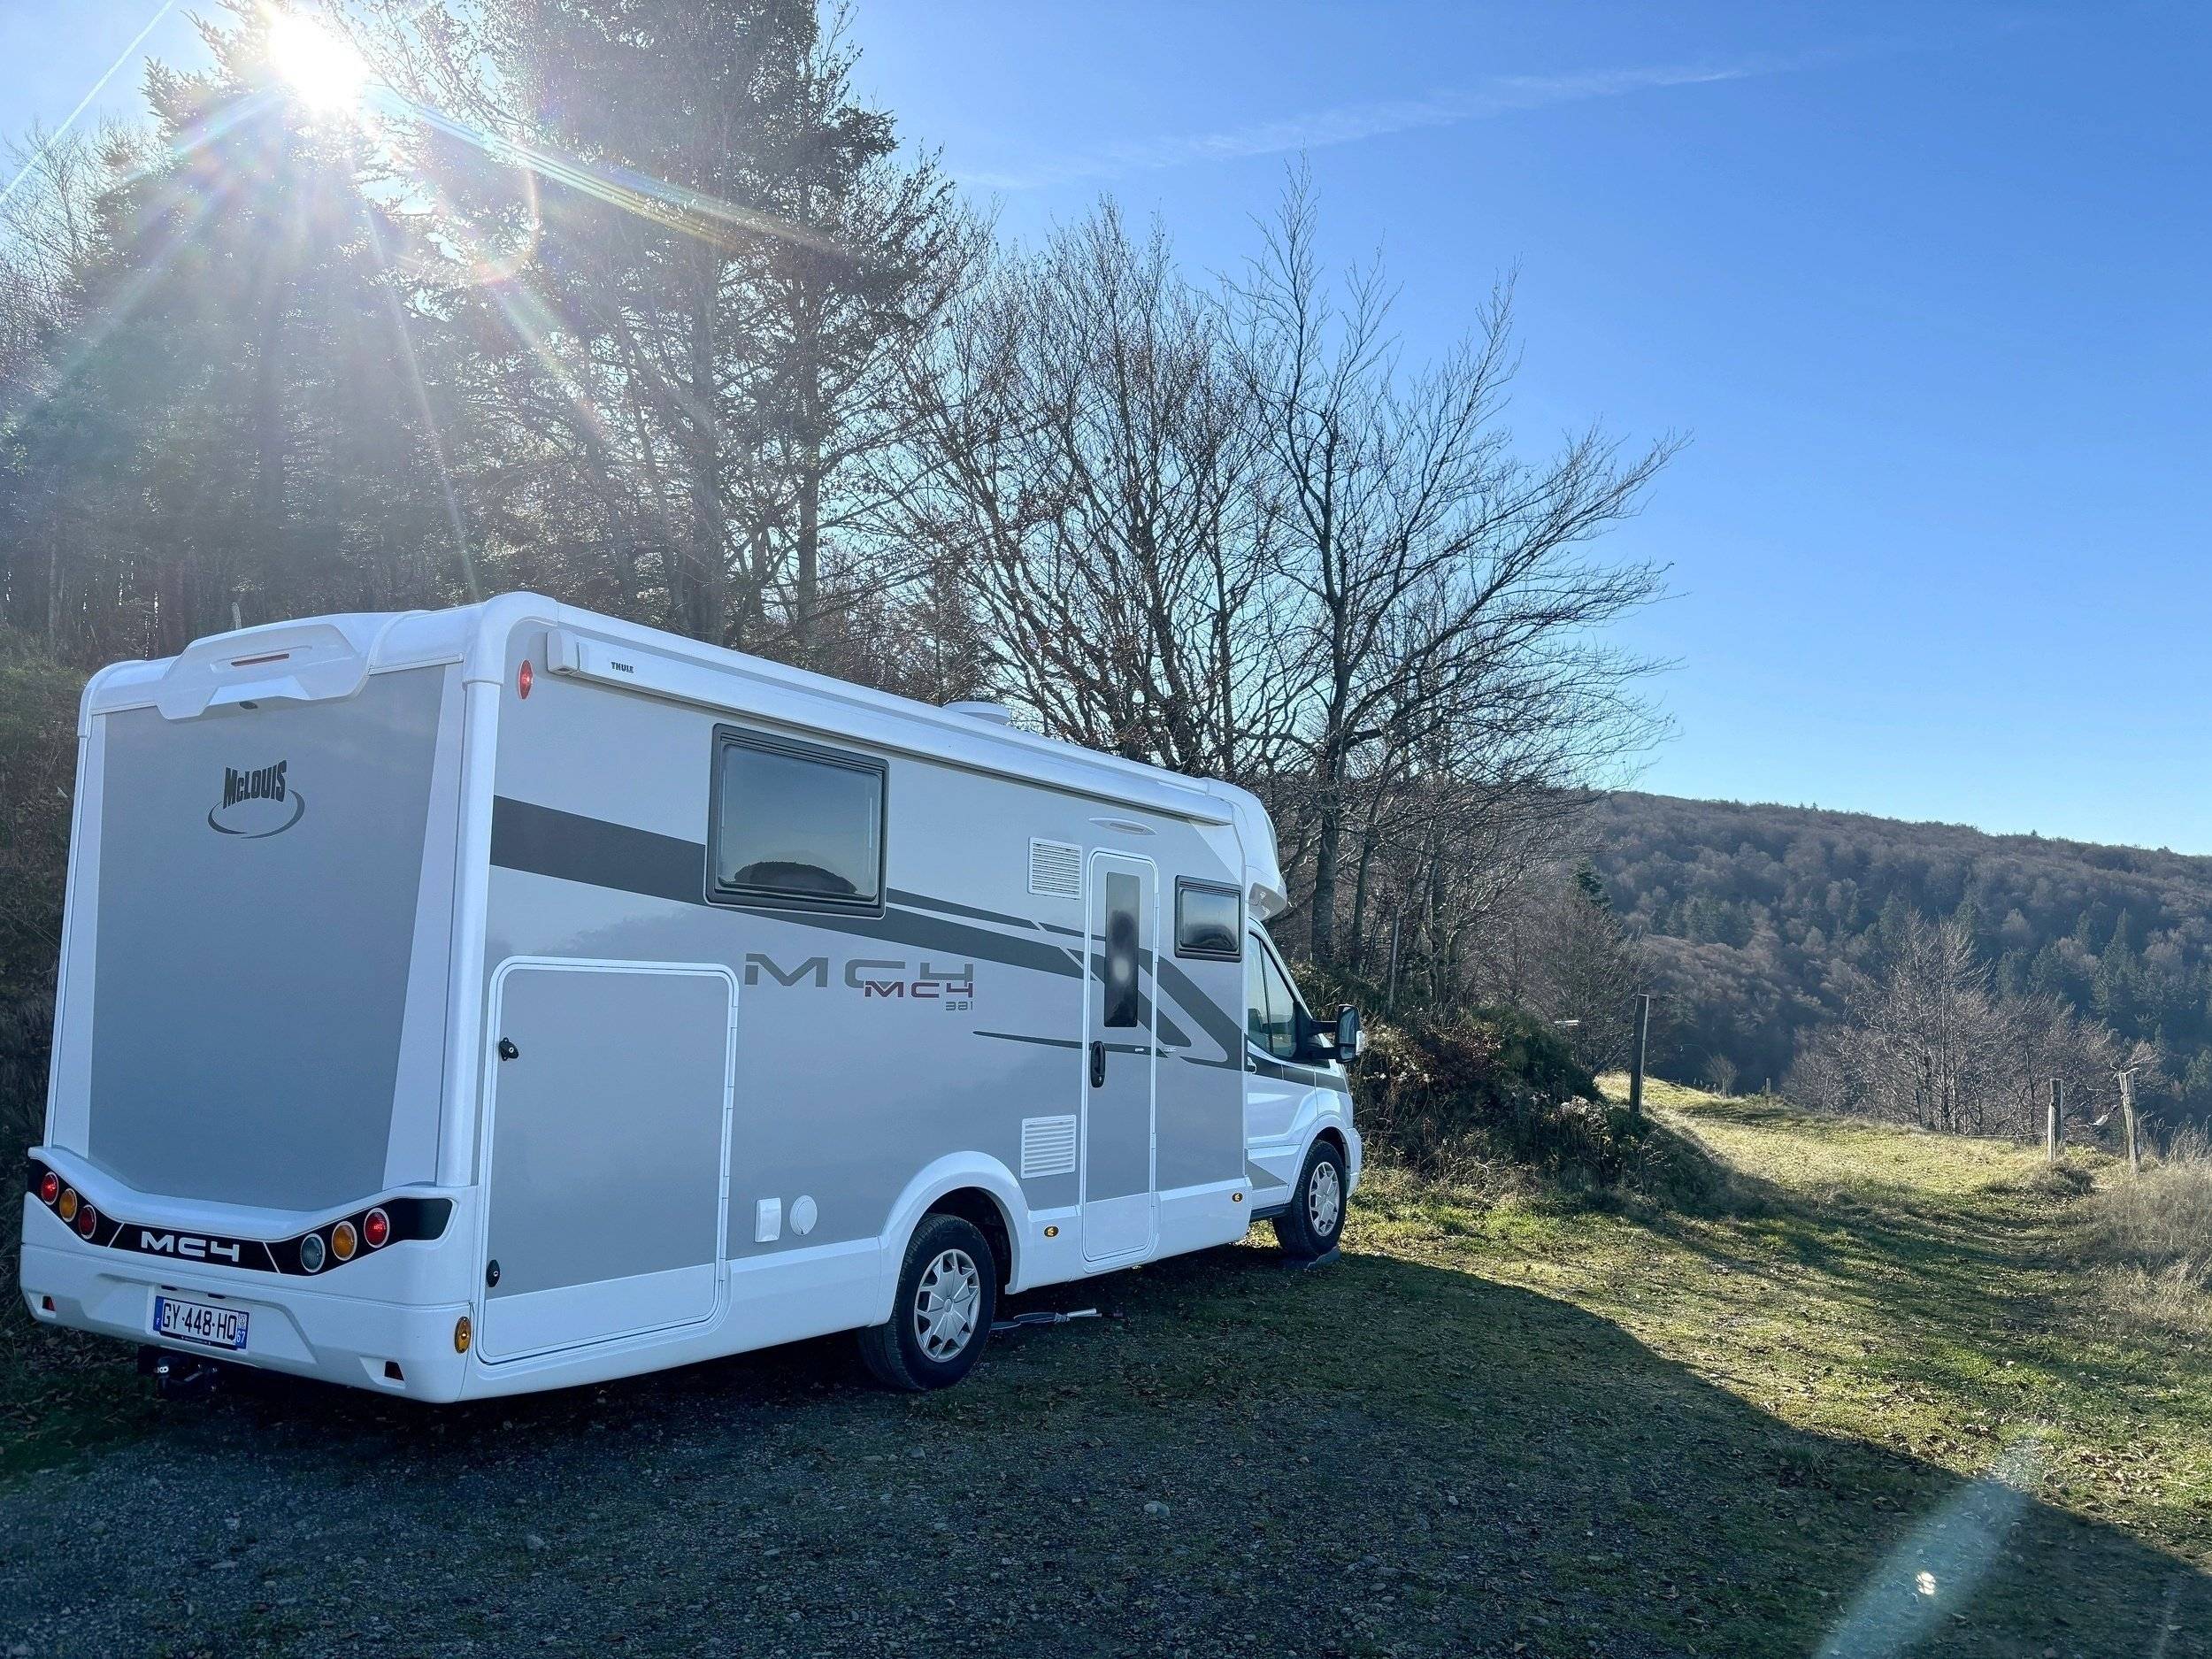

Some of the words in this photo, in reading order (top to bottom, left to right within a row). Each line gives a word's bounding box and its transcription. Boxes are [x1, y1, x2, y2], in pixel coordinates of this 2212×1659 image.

[611, 661, 634, 674] THULE
[744, 953, 973, 988] MC4
[864, 981, 973, 998] MC4
[141, 1231, 240, 1263] MC4
[236, 1330, 246, 1344] 67
